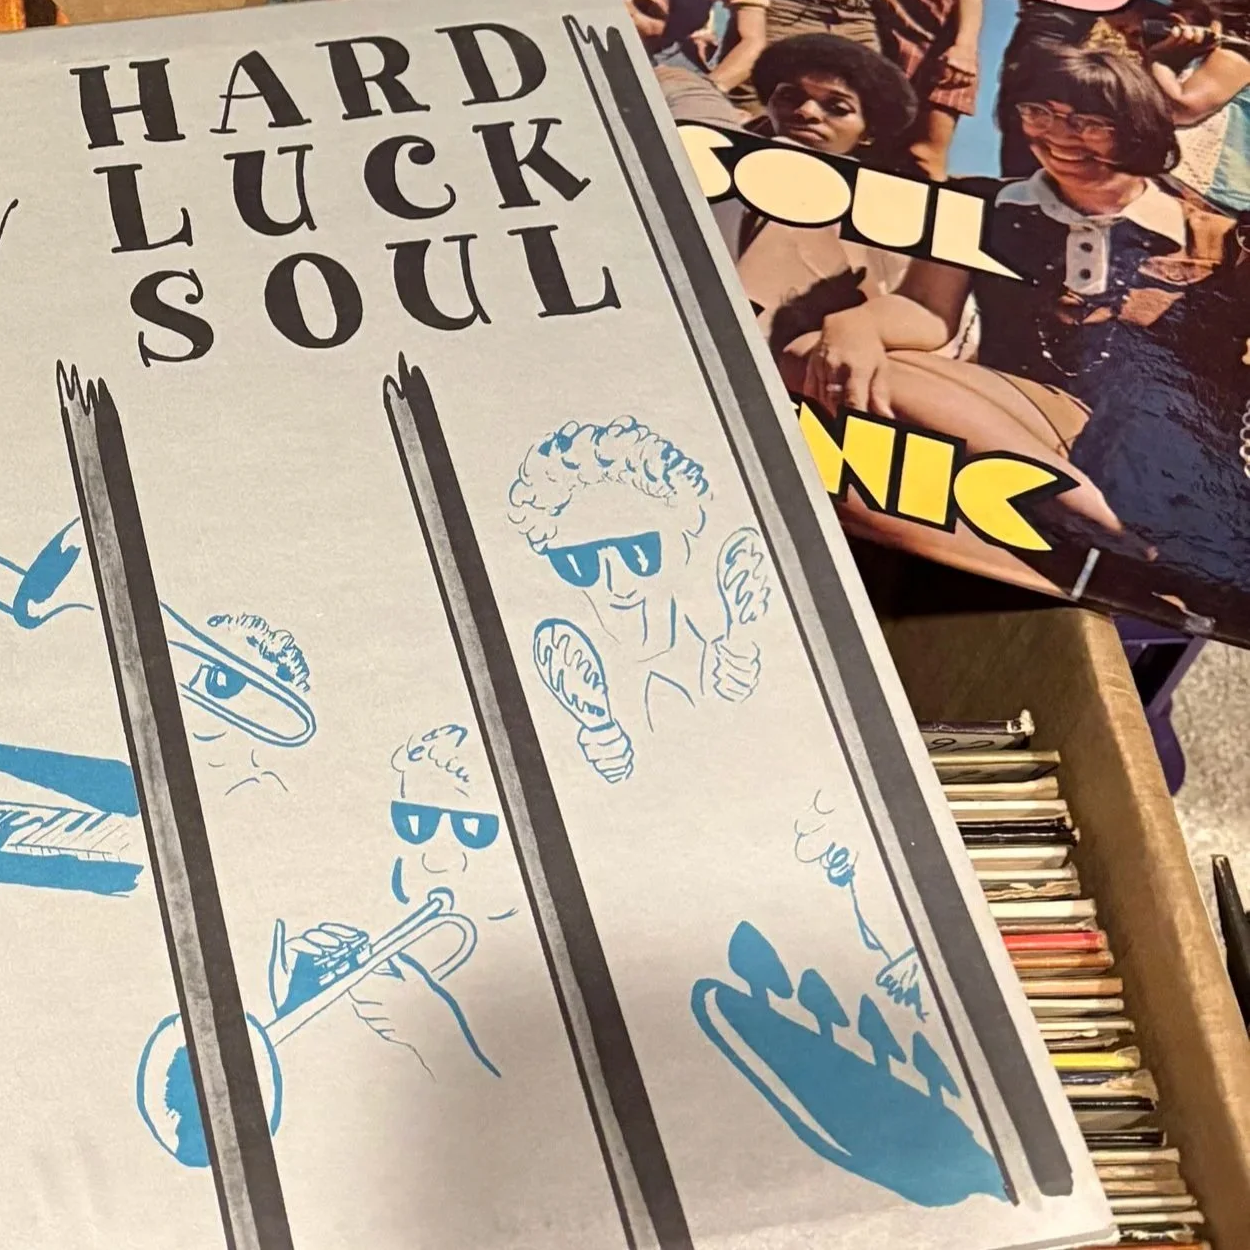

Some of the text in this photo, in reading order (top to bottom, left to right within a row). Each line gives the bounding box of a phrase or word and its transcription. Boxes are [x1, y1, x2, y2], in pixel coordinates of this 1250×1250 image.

[70, 22, 548, 149] HARD
[93, 117, 591, 254] LUCK
[676, 123, 1022, 283] SOUL
[130, 224, 622, 368] SOUL
[792, 392, 1080, 552] NIC
